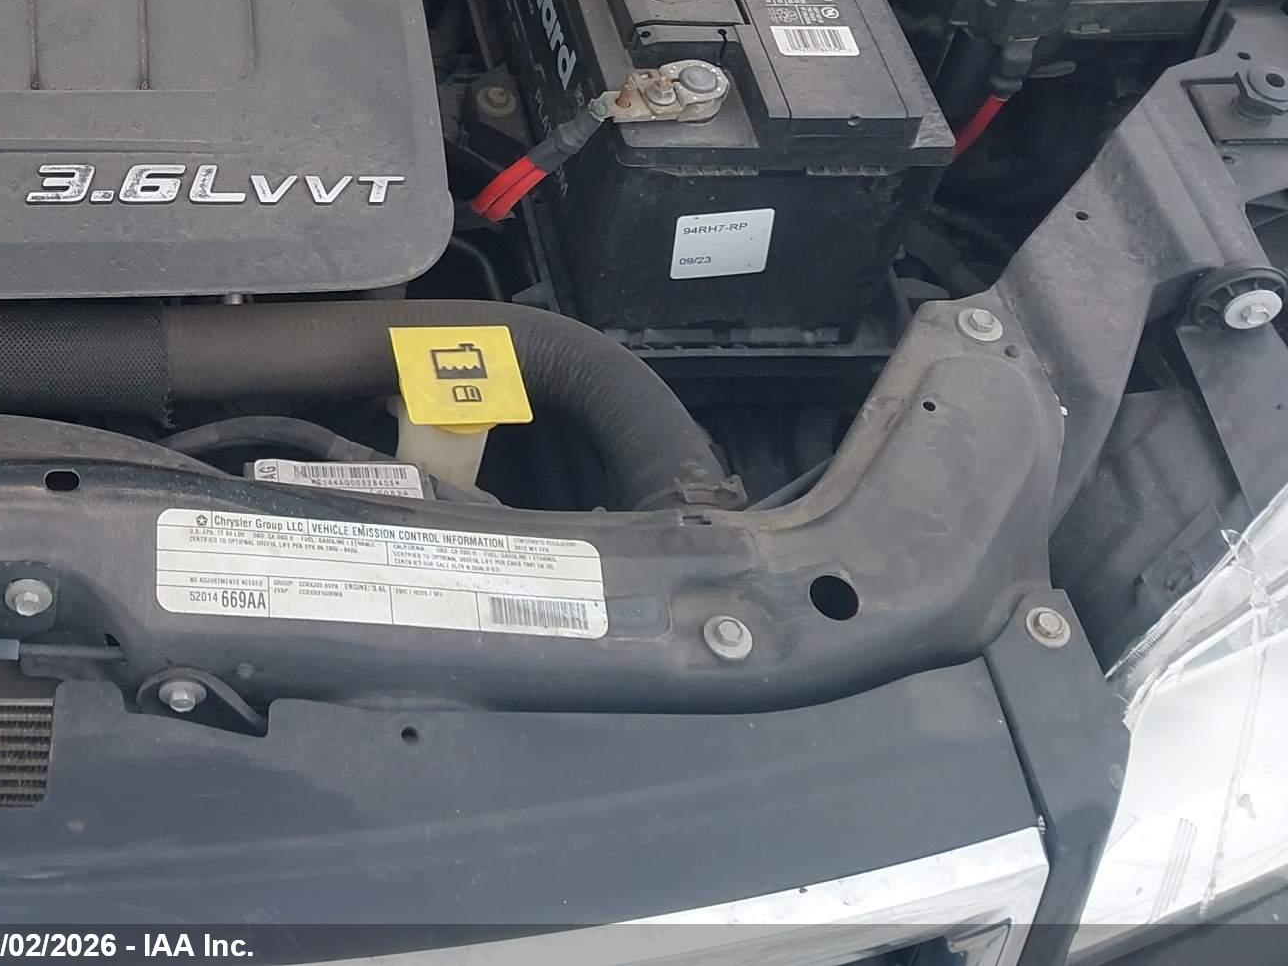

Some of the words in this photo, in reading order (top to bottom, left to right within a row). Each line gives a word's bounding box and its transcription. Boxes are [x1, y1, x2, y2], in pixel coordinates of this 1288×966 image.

[683, 222, 749, 235] 94RH7-RP
[679, 256, 713, 266] 09/23
[214, 515, 252, 530] Chrysler
[255, 518, 283, 532] Group
[286, 521, 304, 532] LLC
[312, 523, 349, 536] VEHICLE
[352, 525, 396, 540] EMISSION
[399, 530, 440, 544] CONTROL
[443, 534, 505, 550] INFORMATION
[221, 590, 266, 610] 669AA
